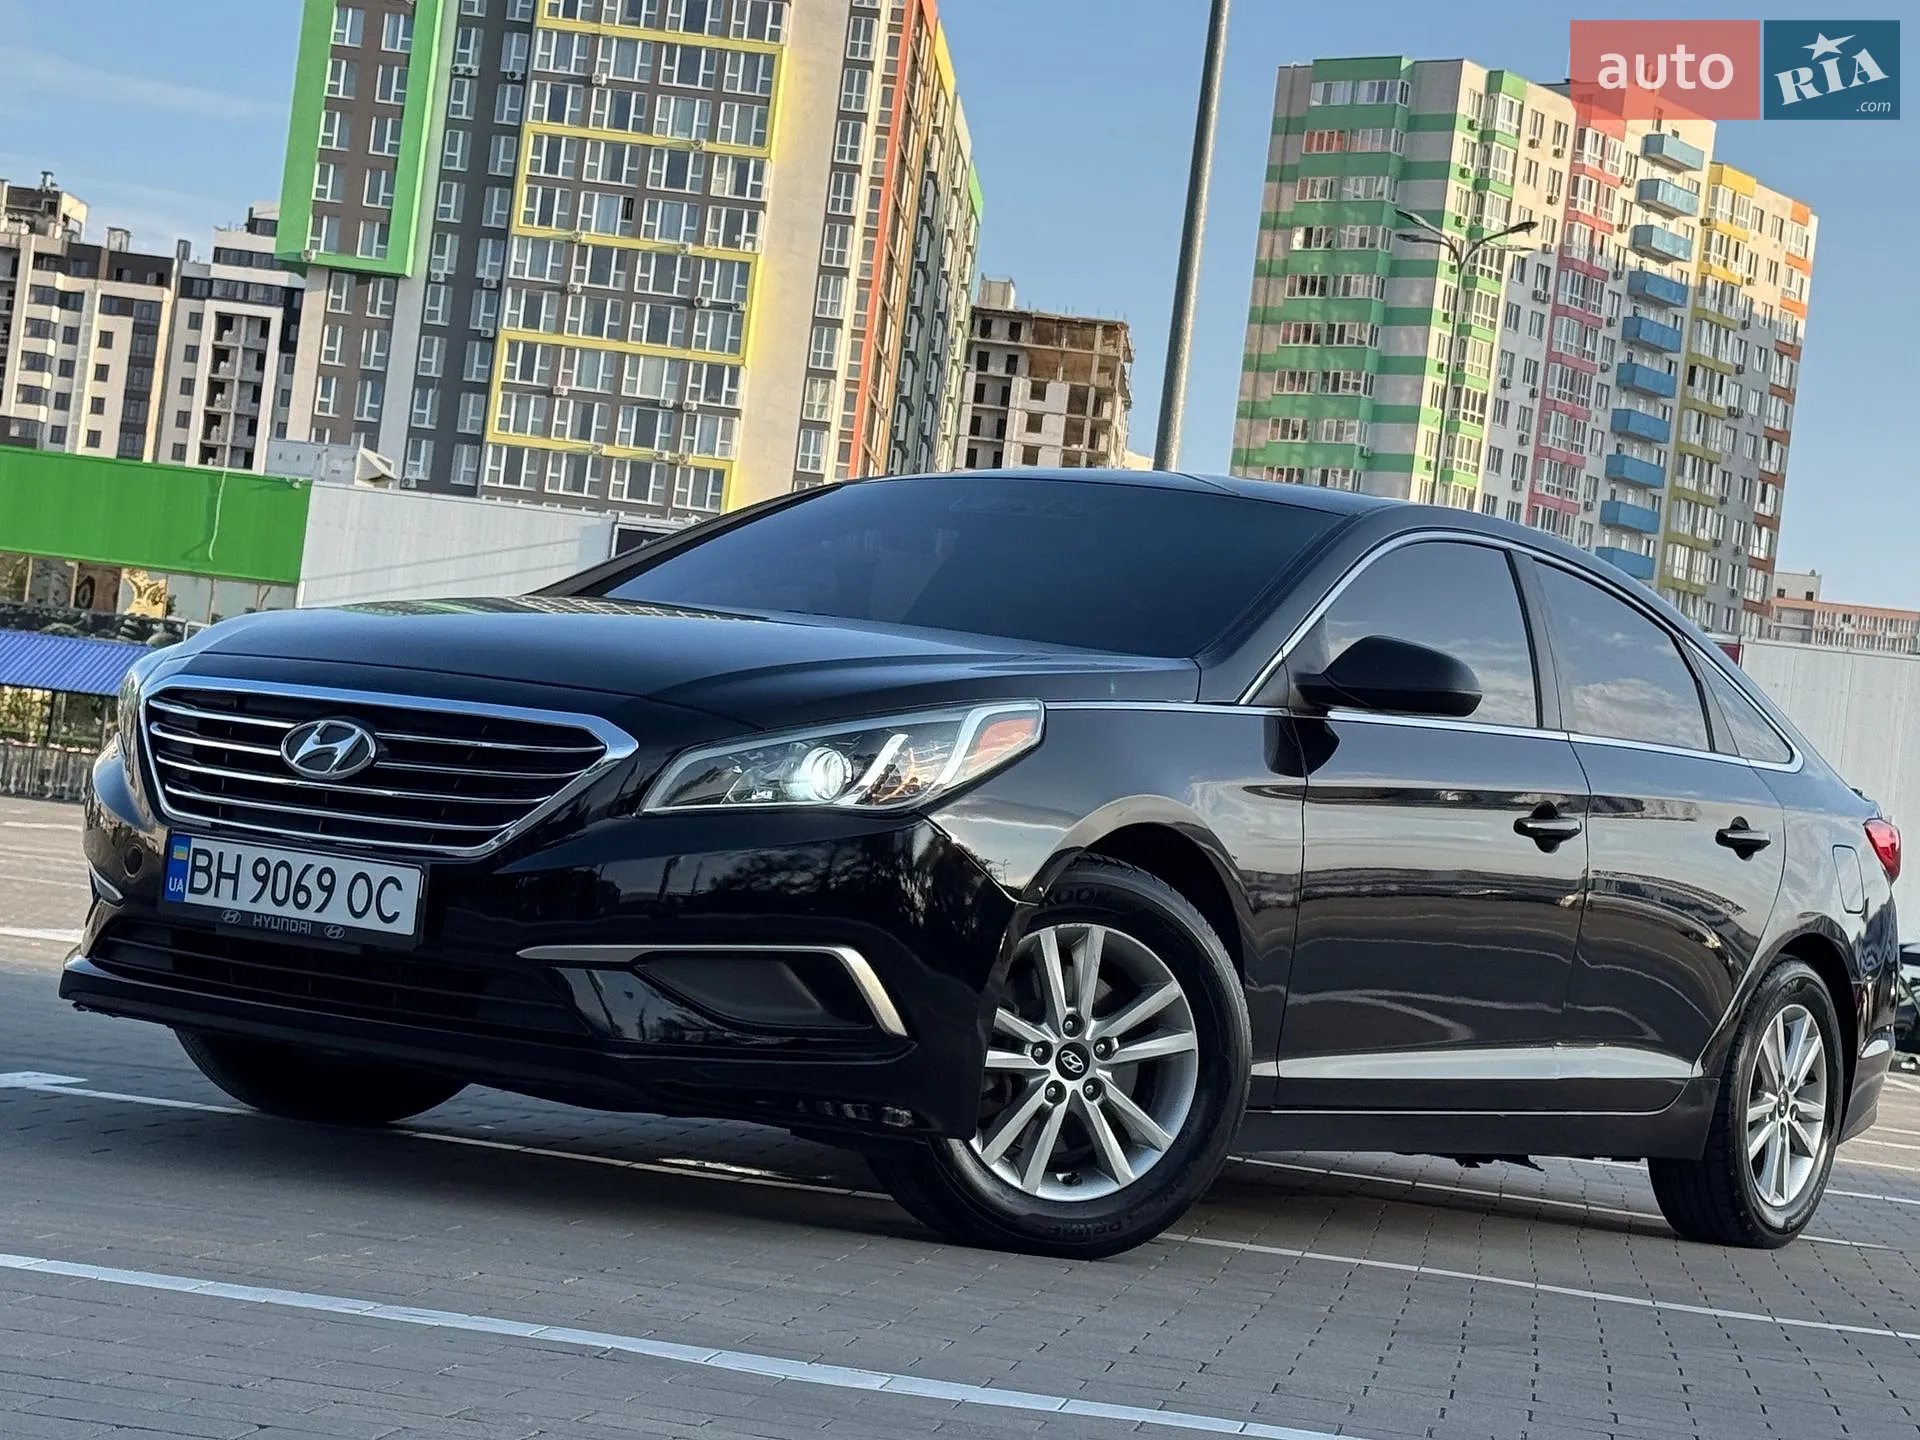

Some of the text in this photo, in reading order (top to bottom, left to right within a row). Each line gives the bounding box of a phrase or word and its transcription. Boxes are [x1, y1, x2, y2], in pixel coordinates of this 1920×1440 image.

[168, 877, 184, 893] UA
[187, 847, 404, 925] BH 9069 OC
[252, 913, 312, 936] HYUNDAI
